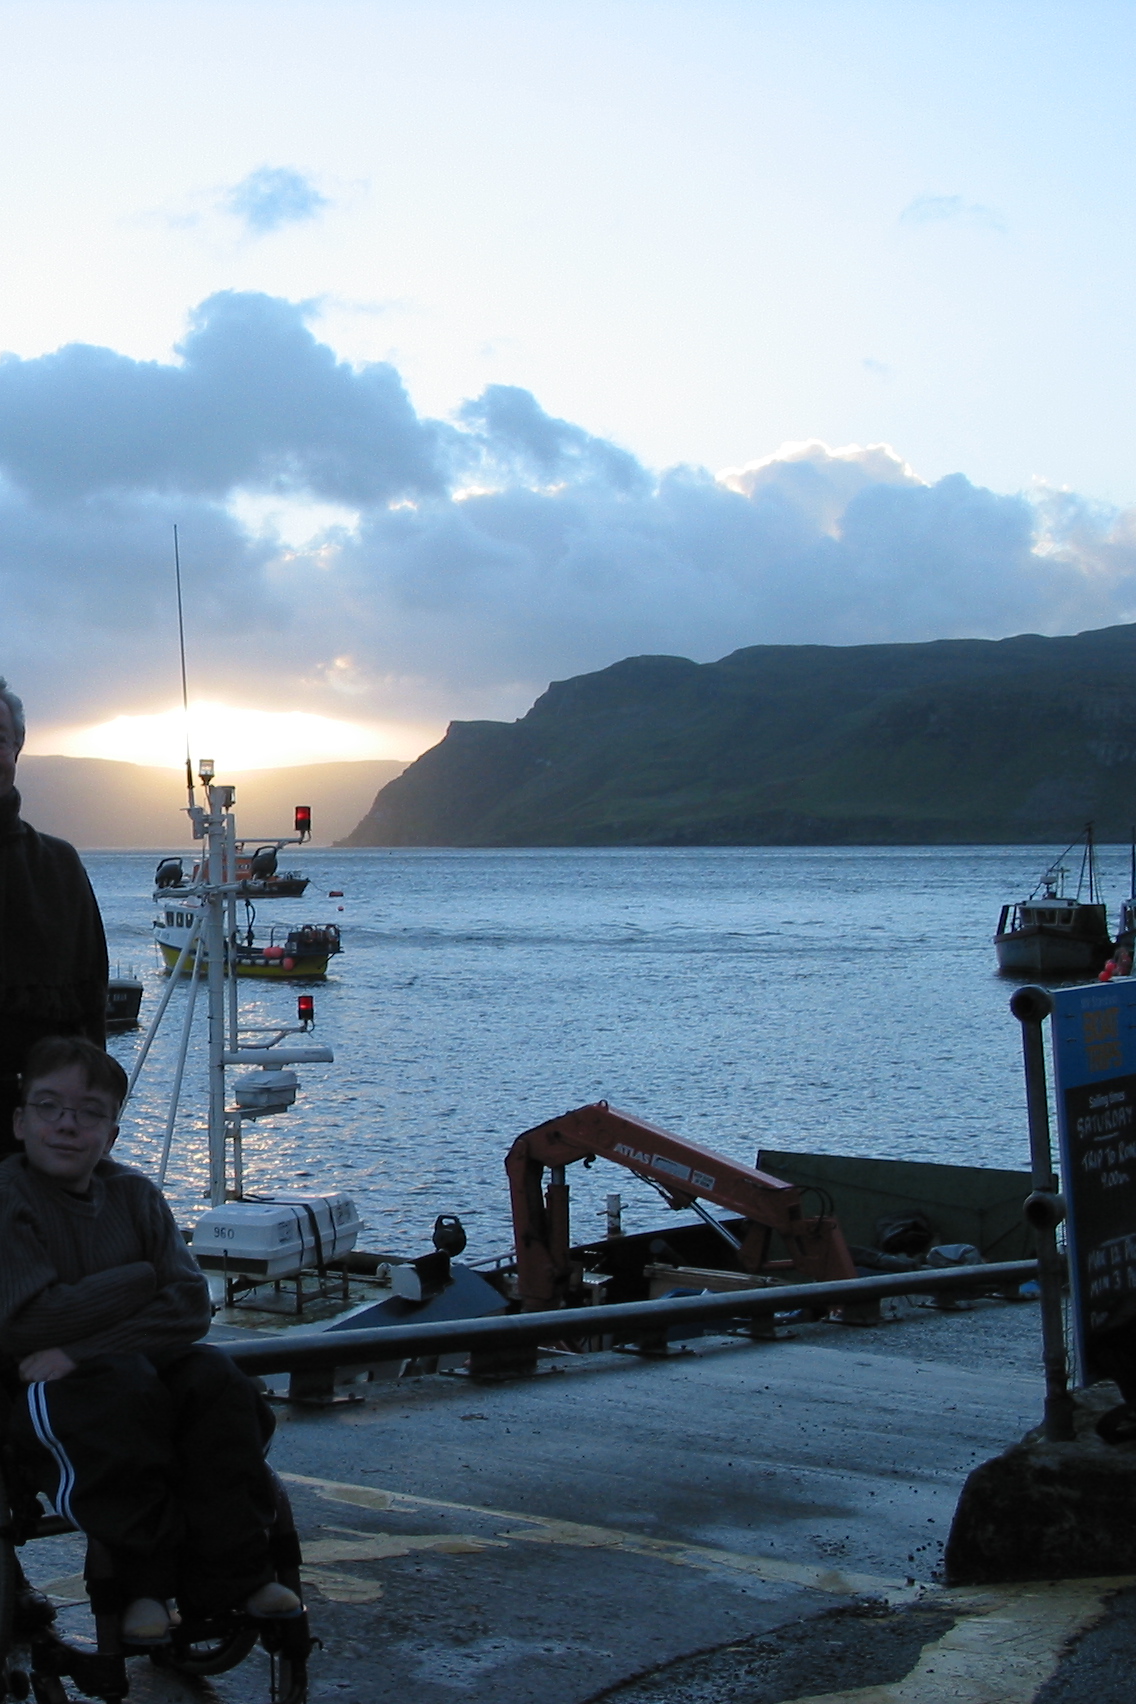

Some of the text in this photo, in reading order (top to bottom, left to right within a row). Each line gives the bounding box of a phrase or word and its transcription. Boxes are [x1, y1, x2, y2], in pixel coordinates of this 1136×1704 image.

[1083, 1007, 1119, 1043] BOAT
[1086, 1041, 1122, 1072] TRIPS
[1077, 1106, 1133, 1139] SATURDAY
[613, 1143, 651, 1165] ATLAS
[214, 1226, 235, 1240] 960
